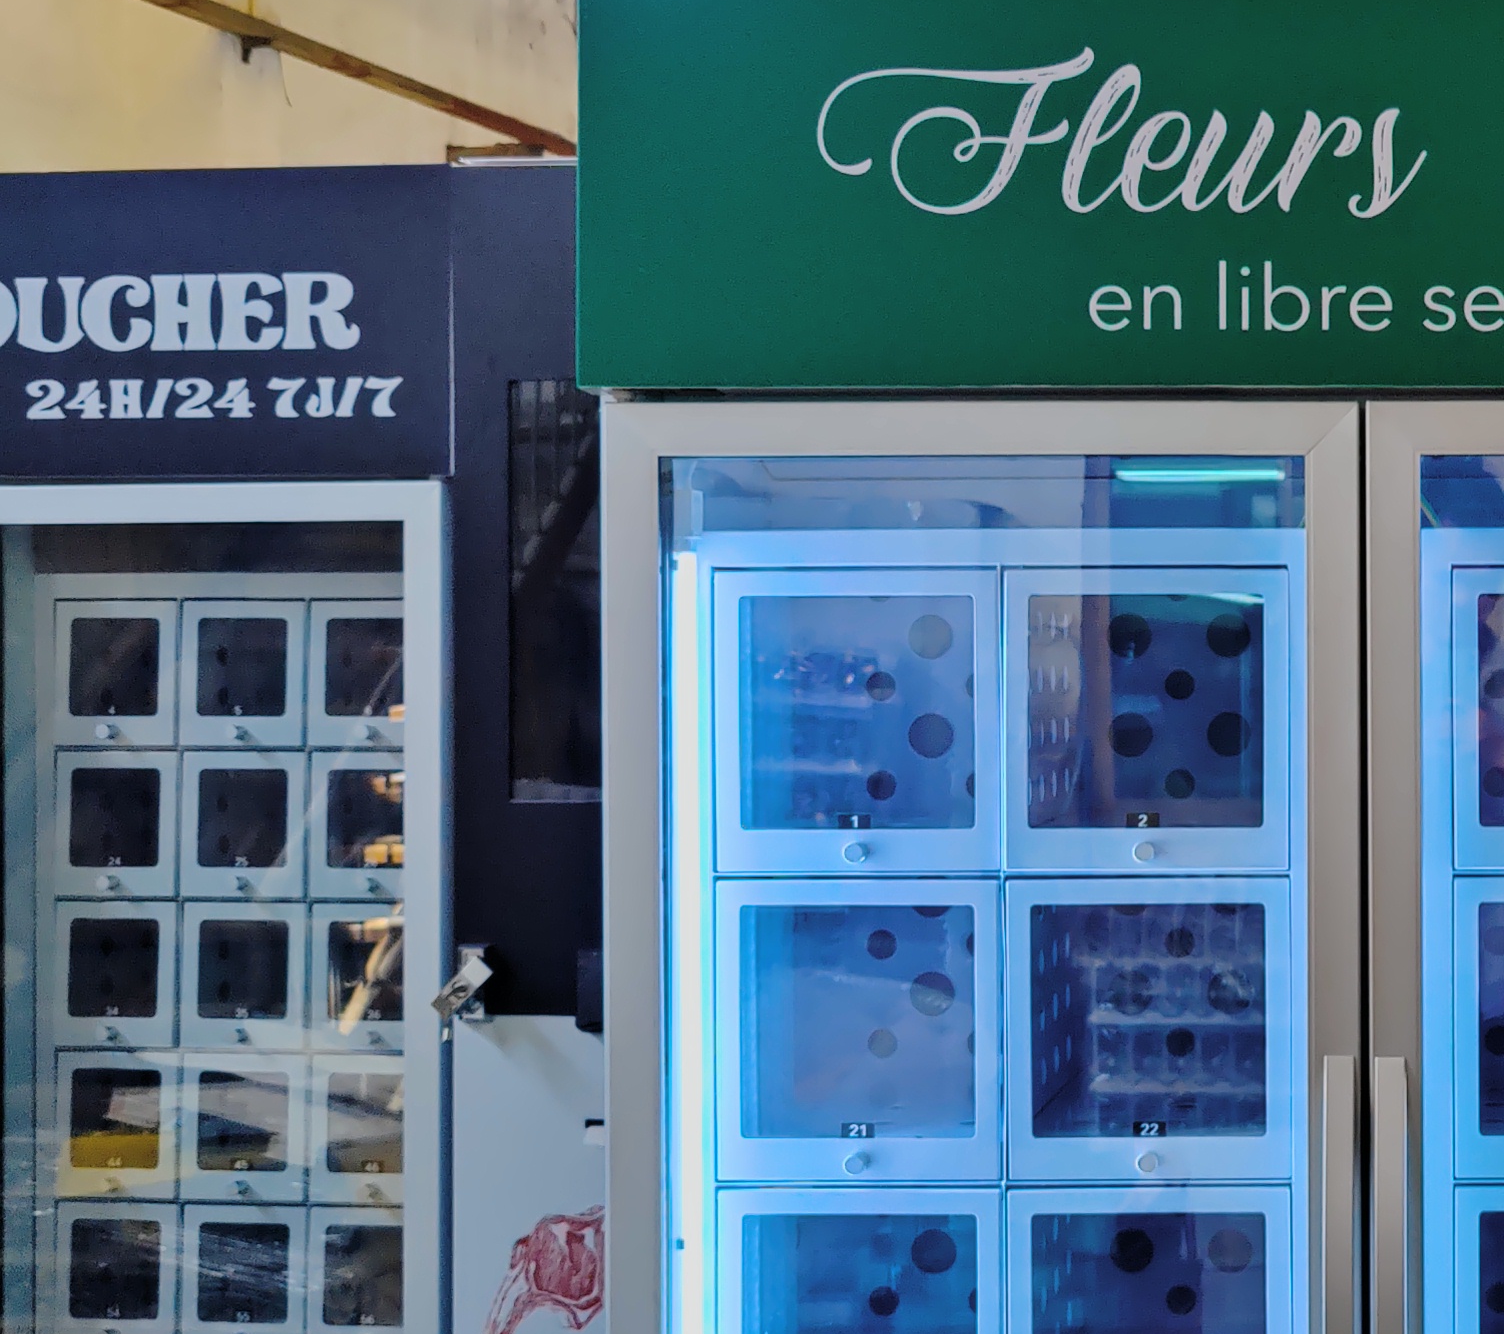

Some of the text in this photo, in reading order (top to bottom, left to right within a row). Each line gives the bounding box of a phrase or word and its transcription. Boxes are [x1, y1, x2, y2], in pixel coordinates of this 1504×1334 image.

[816, 47, 1427, 219] Fleurs
[1089, 284, 1183, 331] en
[1217, 260, 1394, 332] libre
[0, 272, 361, 353] UCHER
[25, 375, 404, 420] 24H/24 7J/7
[851, 816, 858, 828] 1
[1138, 814, 1148, 827] 2
[108, 857, 121, 866] 24
[849, 1123, 867, 1137] 21
[1140, 1123, 1159, 1136] 22
